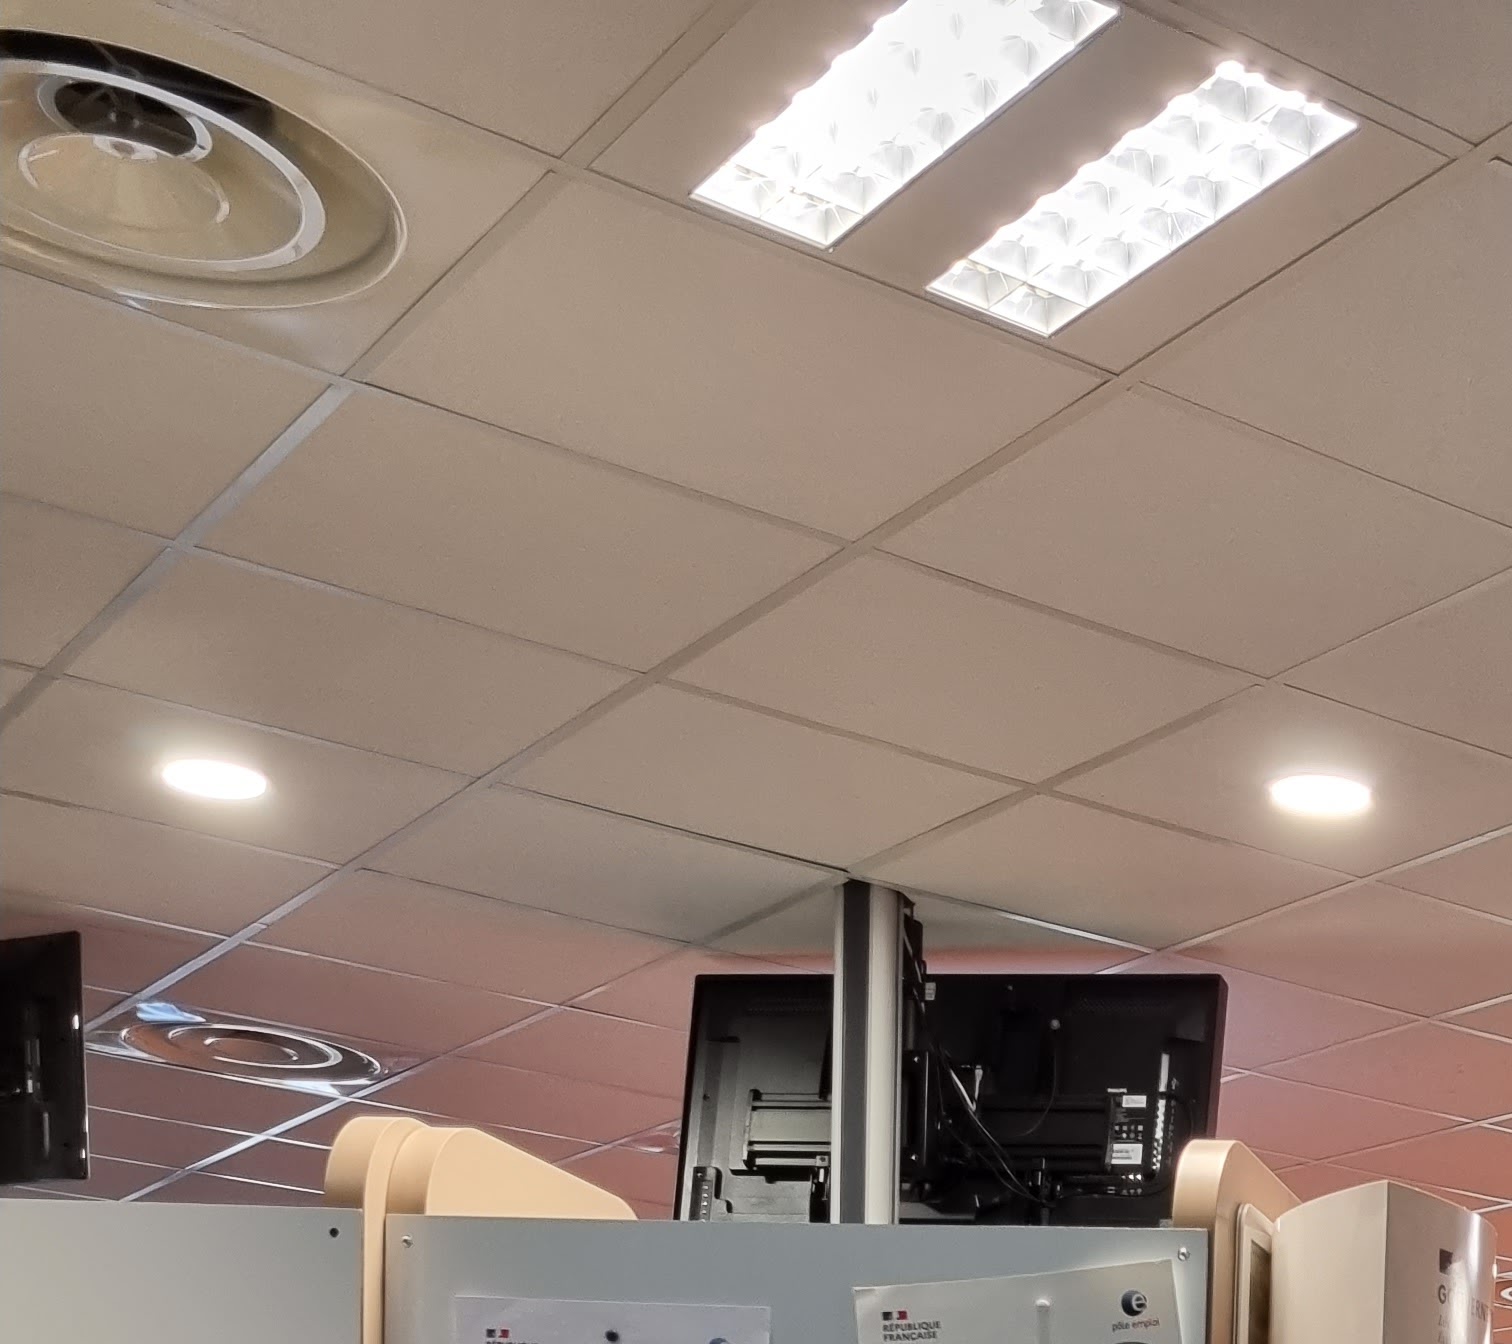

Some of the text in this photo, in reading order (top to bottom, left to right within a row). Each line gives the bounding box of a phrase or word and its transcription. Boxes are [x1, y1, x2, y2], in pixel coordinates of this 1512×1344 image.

[882, 1320, 942, 1332] RÉPUBLIQUE
[1112, 1317, 1160, 1332] pôle emploi
